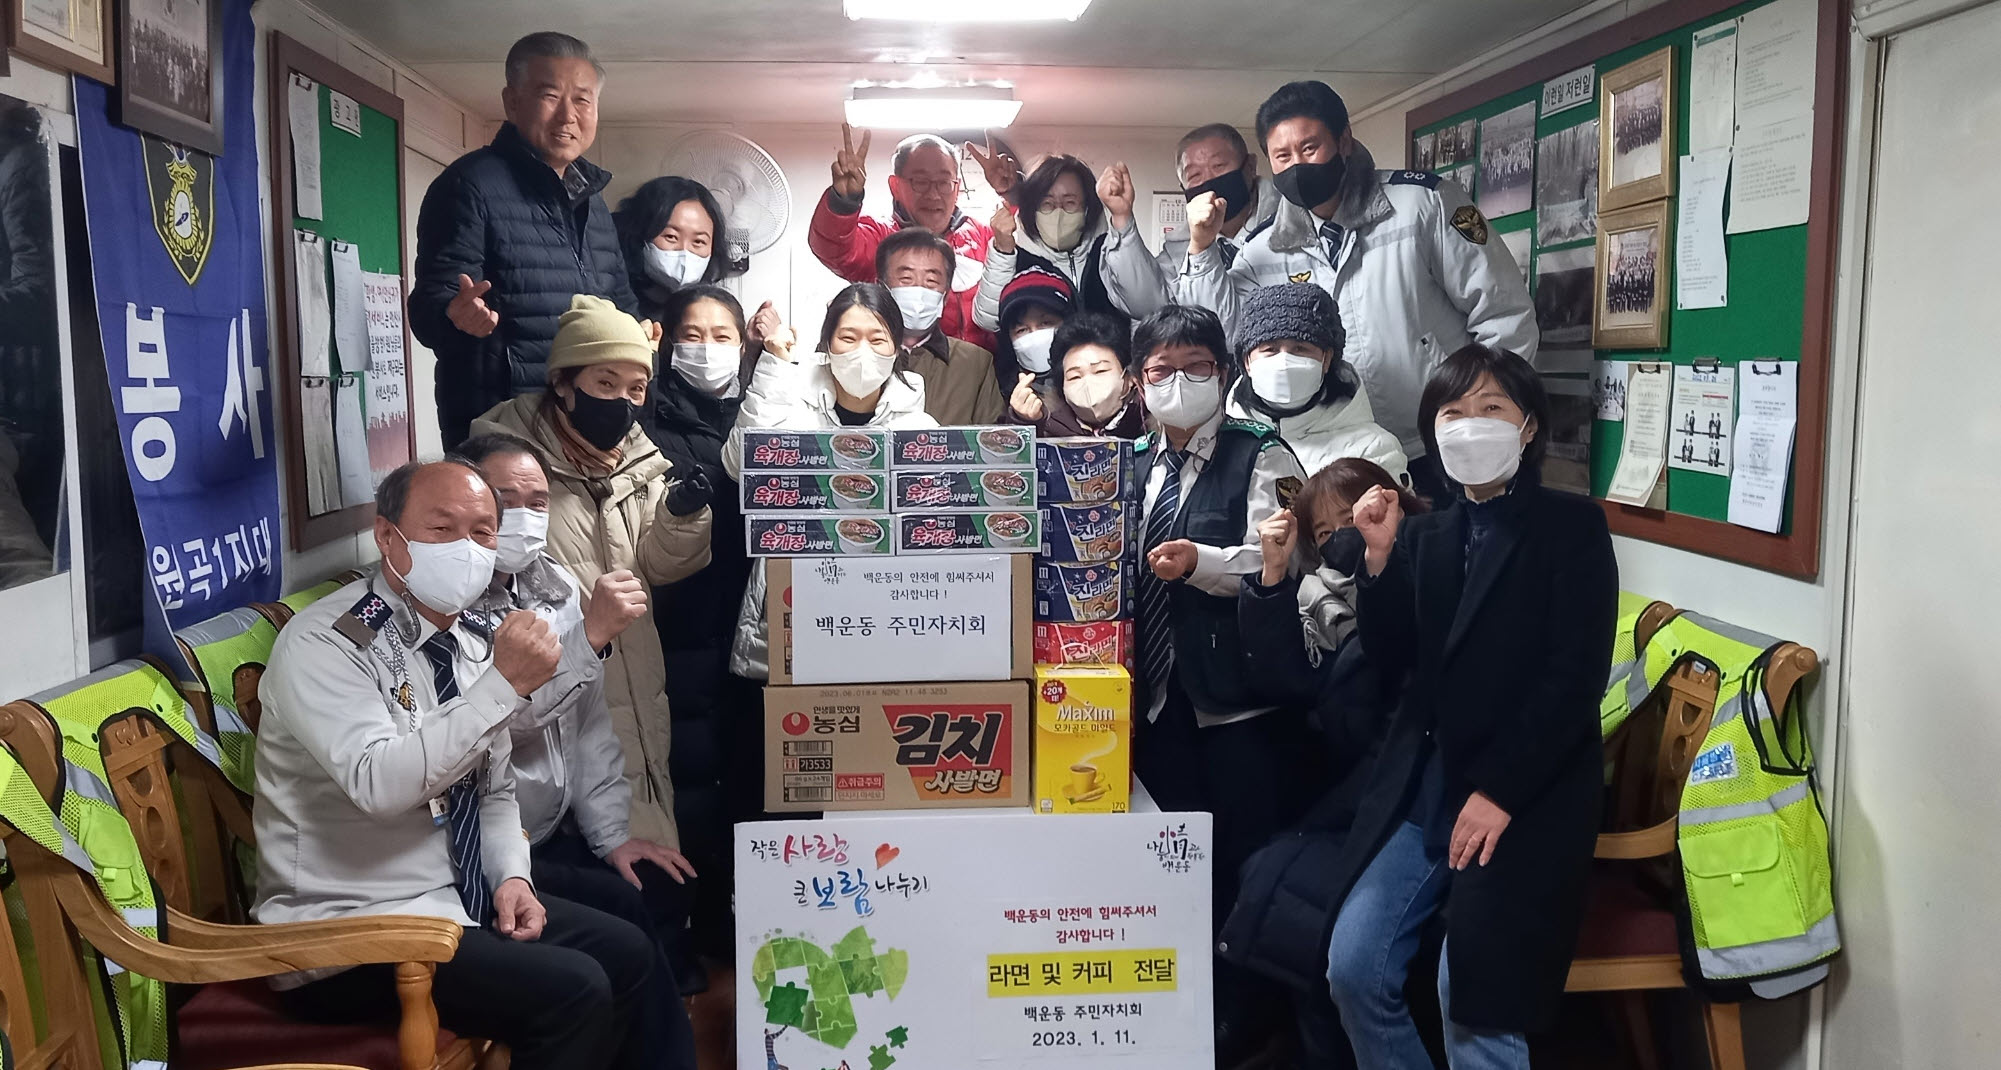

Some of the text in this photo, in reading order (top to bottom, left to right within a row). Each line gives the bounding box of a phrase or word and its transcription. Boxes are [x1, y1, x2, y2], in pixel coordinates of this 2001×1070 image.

[1545, 73, 1591, 107] 이런일 저런일
[121, 302, 265, 482] 봉 사
[753, 445, 800, 467] 육개장
[902, 441, 949, 462] 육개장
[1071, 457, 1113, 481] 진라면
[753, 485, 800, 506] 육개장
[1075, 516, 1117, 541] 진라면
[759, 530, 806, 552] 육개장
[863, 571, 903, 583] 백운동의
[909, 571, 940, 583] 안전에
[890, 589, 939, 601] 감사합니다
[1072, 576, 1114, 601] 진라면
[815, 615, 986, 637] 백운동 주민자치회
[1056, 704, 1115, 721] Maxim
[813, 716, 860, 734] 농심
[892, 712, 1003, 767] 김치
[848, 777, 882, 787] 취급주의
[924, 769, 1002, 793] 사발면
[1112, 801, 1126, 810] 170
[750, 833, 849, 864] 작은 사랑
[793, 868, 928, 915] 큰 보람 나누기
[1004, 905, 1157, 924] 백운동의 안전에 힘써주셔서
[1056, 929, 1115, 944] 감사합니다
[989, 958, 1175, 987] 라면 및 커피 전달
[1024, 1003, 1143, 1022] 백운동 주민자치회
[1032, 1029, 1136, 1047] 2023. 1. 11.
